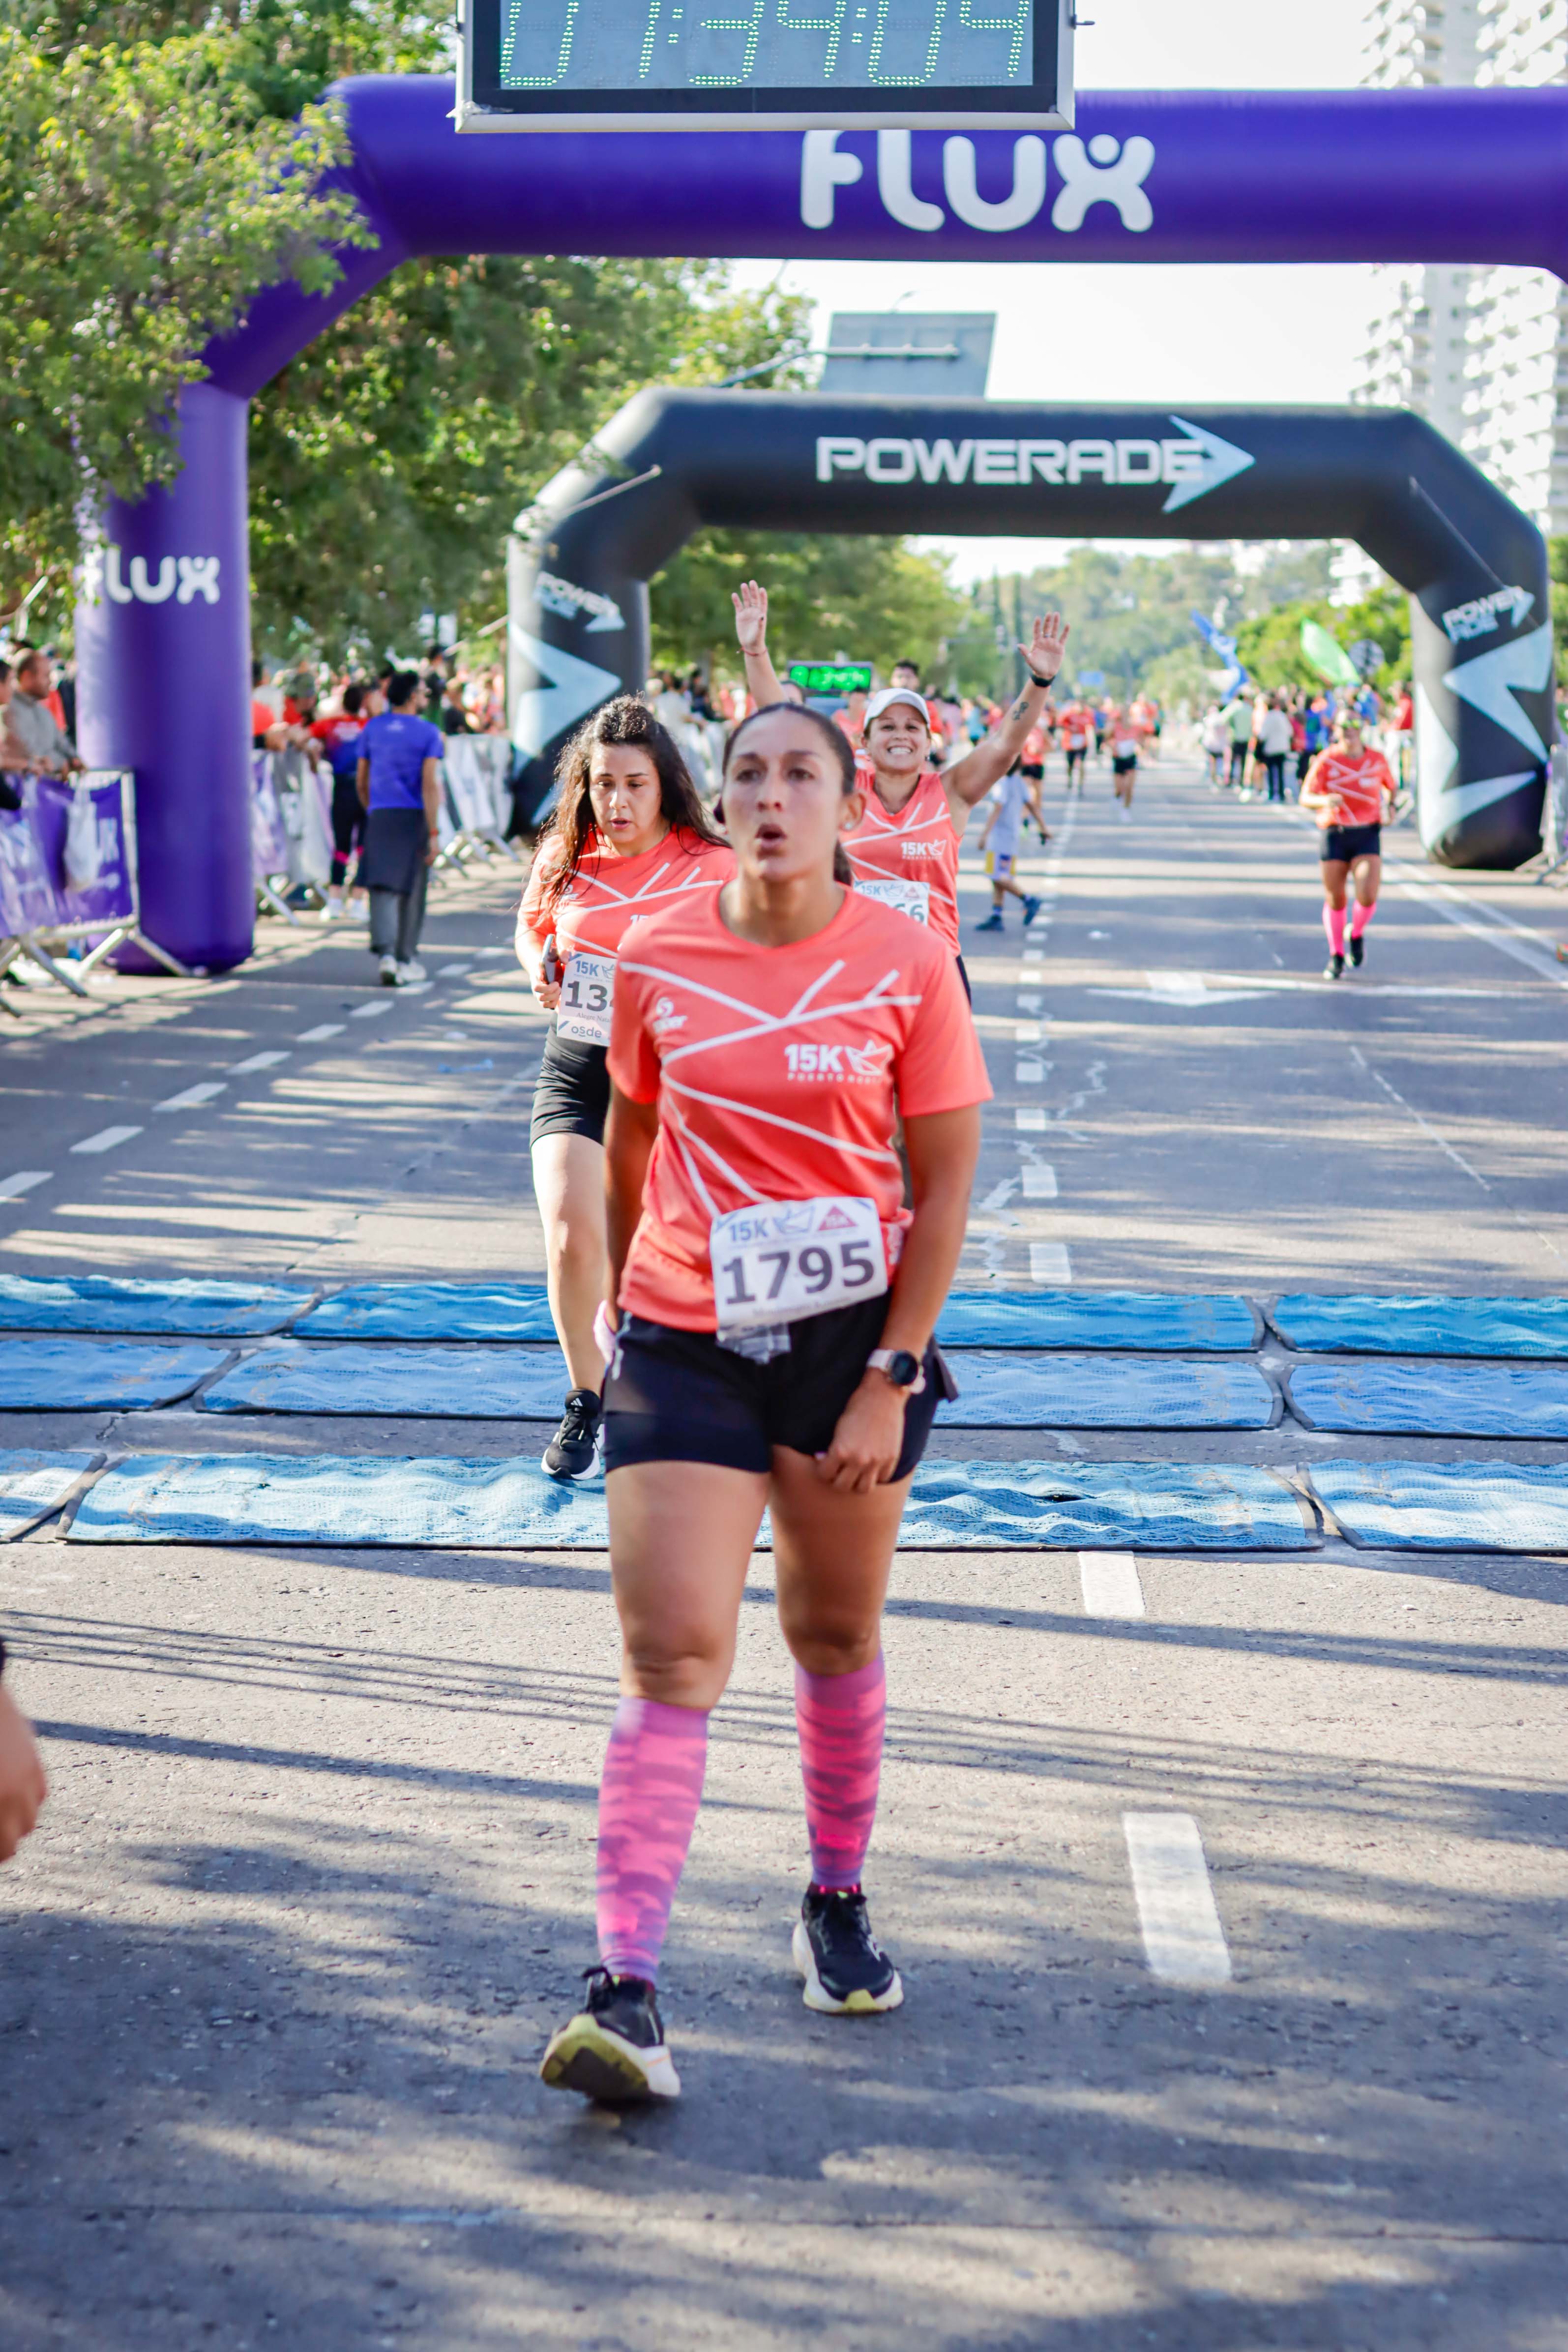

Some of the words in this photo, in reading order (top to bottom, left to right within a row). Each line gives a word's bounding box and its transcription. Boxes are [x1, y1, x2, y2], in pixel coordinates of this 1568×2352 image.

[816, 436, 1205, 485] POWERADE
[901, 841, 927, 855] 15K
[861, 885, 882, 896] 15K
[894, 903, 925, 923] 6
[576, 960, 600, 977] 15K
[565, 980, 614, 1012] 13
[571, 1026, 602, 1038] osde
[784, 1043, 844, 1073] 15K
[729, 1218, 769, 1242] 15K
[723, 1240, 875, 1305] 1795
